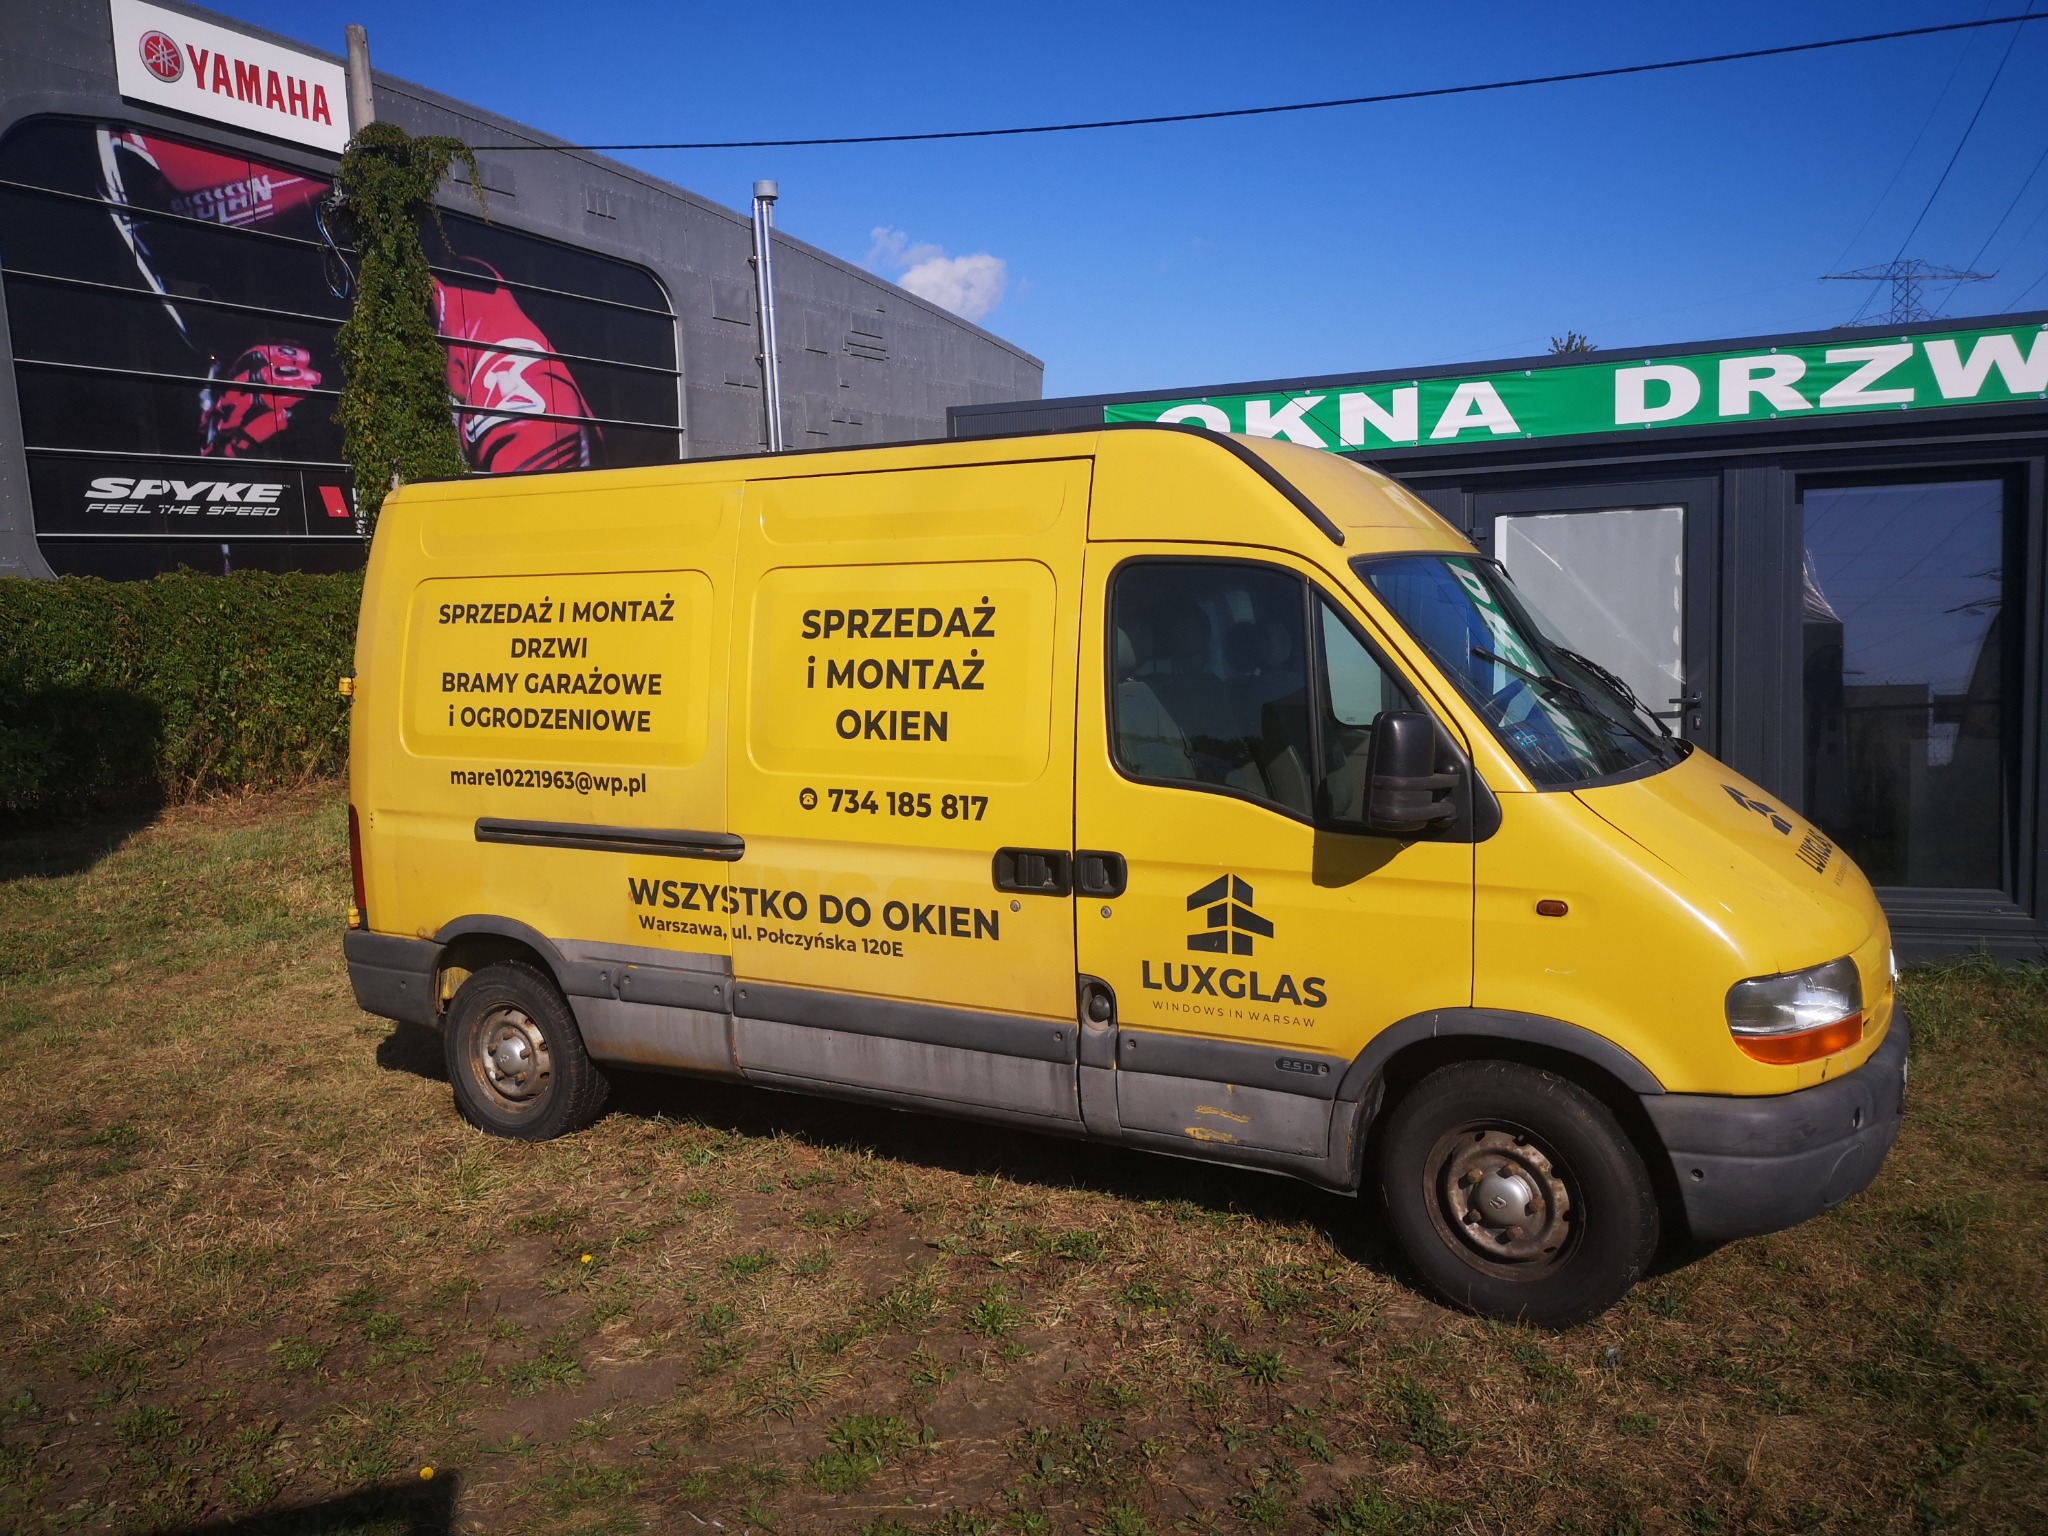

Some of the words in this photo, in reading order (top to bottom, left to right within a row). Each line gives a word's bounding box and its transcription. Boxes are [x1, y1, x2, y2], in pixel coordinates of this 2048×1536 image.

[185, 43, 333, 127] YAMAHA
[84, 477, 284, 503] SPYKE
[86, 503, 152, 514] FEEL
[158, 504, 201, 515] THE
[206, 505, 280, 517] SPEED
[438, 595, 553, 625] SPRZEDAŻ
[572, 592, 675, 623] MONTAŻ
[801, 595, 996, 640] SPRZEDAŻ
[510, 637, 588, 659] DRZWI
[441, 671, 519, 694] BRAMY
[524, 666, 662, 696] GARAŻOWE
[807, 655, 816, 689] i
[826, 648, 985, 691] MONTAŻ
[448, 703, 455, 727] i
[460, 706, 651, 733] OGRODZENIOWE
[835, 708, 949, 743] OKIEN
[450, 768, 647, 798] mare10221963@wp.pl
[827, 788, 879, 816] 734
[886, 791, 932, 819] 185
[940, 793, 989, 822] 817
[627, 876, 808, 922] WSZYSTKO
[818, 893, 872, 928] DO
[882, 900, 1000, 942] OKIEN
[638, 913, 728, 941] Warszawa,
[732, 926, 752, 942] ul.
[756, 926, 857, 954] Połczyńska
[862, 937, 904, 958] 120E
[1141, 959, 1328, 1009] LUXGLAS
[1152, 1000, 1225, 1018] WINDOWS
[1228, 1008, 1244, 1020] IN
[1248, 1010, 1316, 1028] WARSAW
